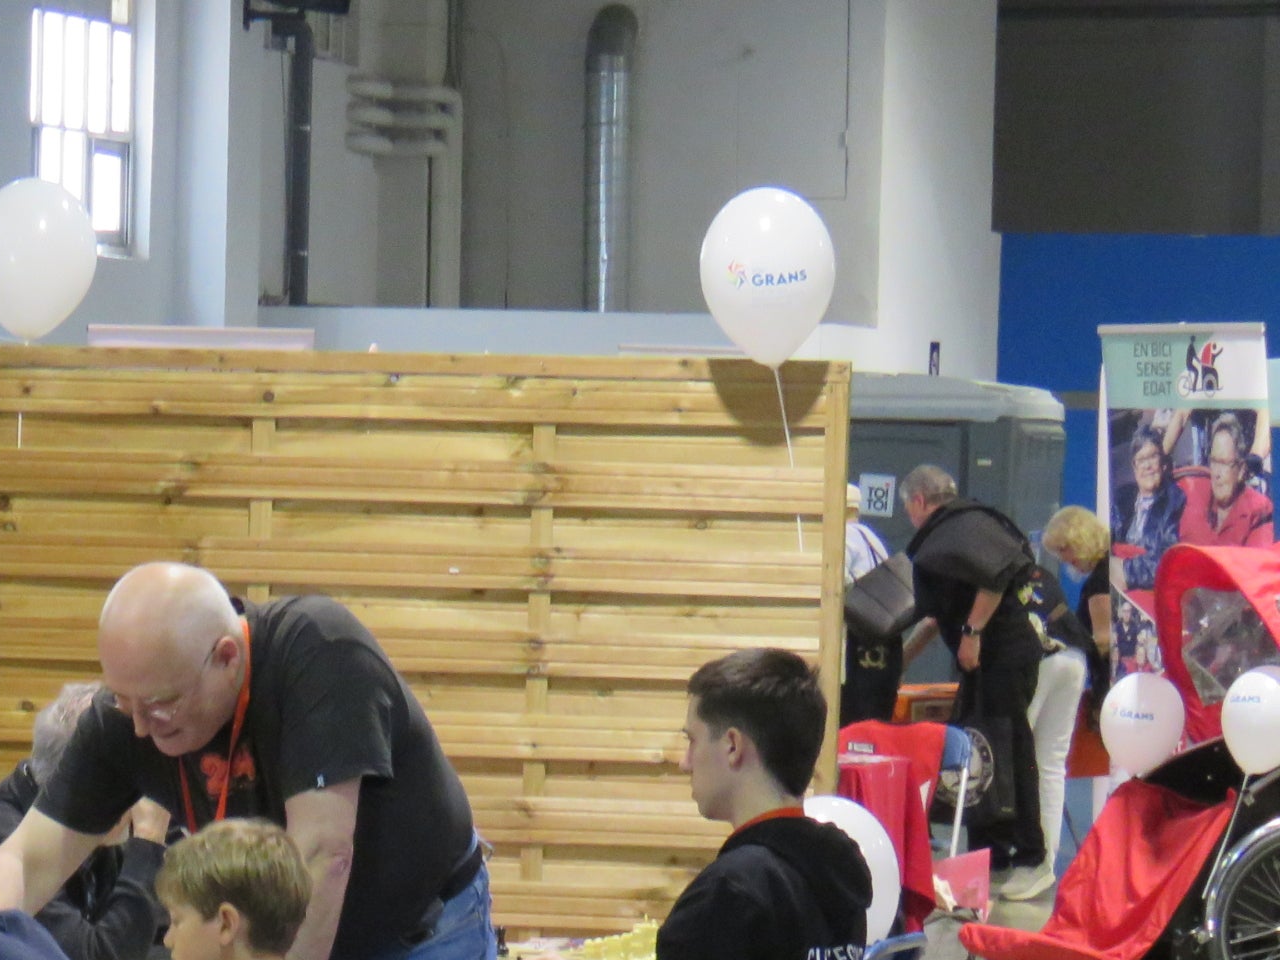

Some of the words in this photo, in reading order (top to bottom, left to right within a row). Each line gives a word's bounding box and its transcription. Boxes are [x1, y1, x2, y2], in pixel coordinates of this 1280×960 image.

[751, 269, 807, 287] GRANS
[1133, 342, 1148, 358] EN
[1150, 341, 1172, 357] BICI
[1136, 361, 1172, 377] SENSE
[1143, 380, 1172, 397] EDAT
[867, 499, 888, 511] TOI
